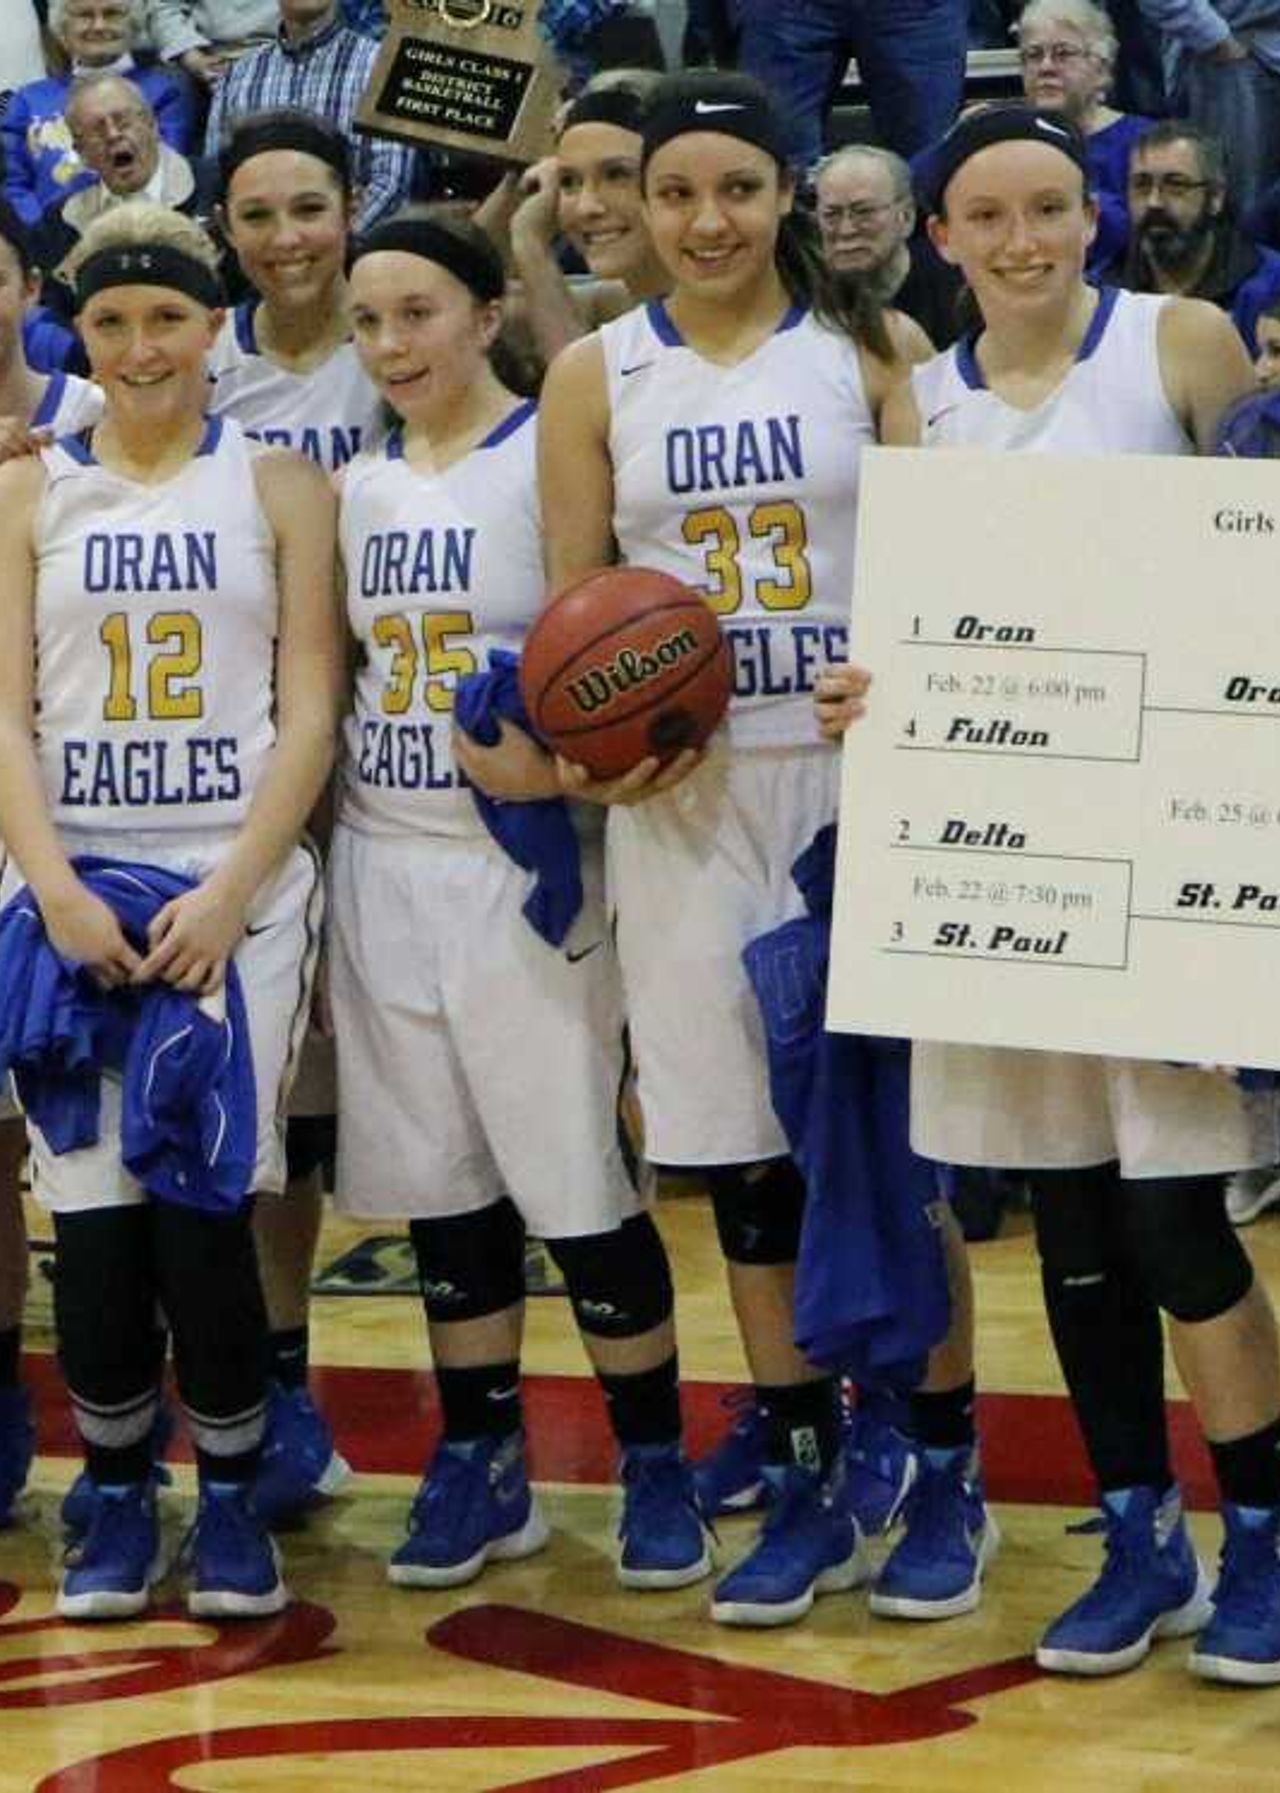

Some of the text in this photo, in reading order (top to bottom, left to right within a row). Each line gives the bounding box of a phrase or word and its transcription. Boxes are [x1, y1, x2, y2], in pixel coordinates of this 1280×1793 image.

[405, 47, 455, 68] GIRLS
[459, 58, 511, 80] CLASS
[401, 77, 502, 110] BASKETBALL
[419, 70, 495, 95] DISTRICT
[395, 96, 496, 128] FIRST PLACE
[666, 415, 805, 494] ORAN
[1214, 510, 1275, 534] Girls
[84, 532, 218, 594] ORAN
[361, 528, 477, 598] ORAN
[682, 499, 812, 615] 33
[912, 615, 1036, 643] 1 Oran
[100, 611, 204, 720] 12
[372, 611, 477, 714] 35
[566, 627, 698, 712] Wilson
[927, 673, 966, 693] Feb.
[971, 675, 995, 696] 22
[1027, 678, 1070, 698] 6:00
[1075, 684, 1105, 706] pm
[904, 718, 1050, 747] 4 Fulton
[61, 738, 242, 806] EAGLES
[1171, 798, 1211, 821] Feb.
[1217, 803, 1242, 823] 25
[898, 820, 1026, 849] 2 Delta
[913, 876, 952, 898] Feb.
[956, 880, 982, 900] 22
[1013, 884, 1058, 905] 7:30
[1062, 889, 1093, 910] pm
[1176, 882, 1221, 909] St.
[890, 921, 1069, 955] 3 St. Paul
